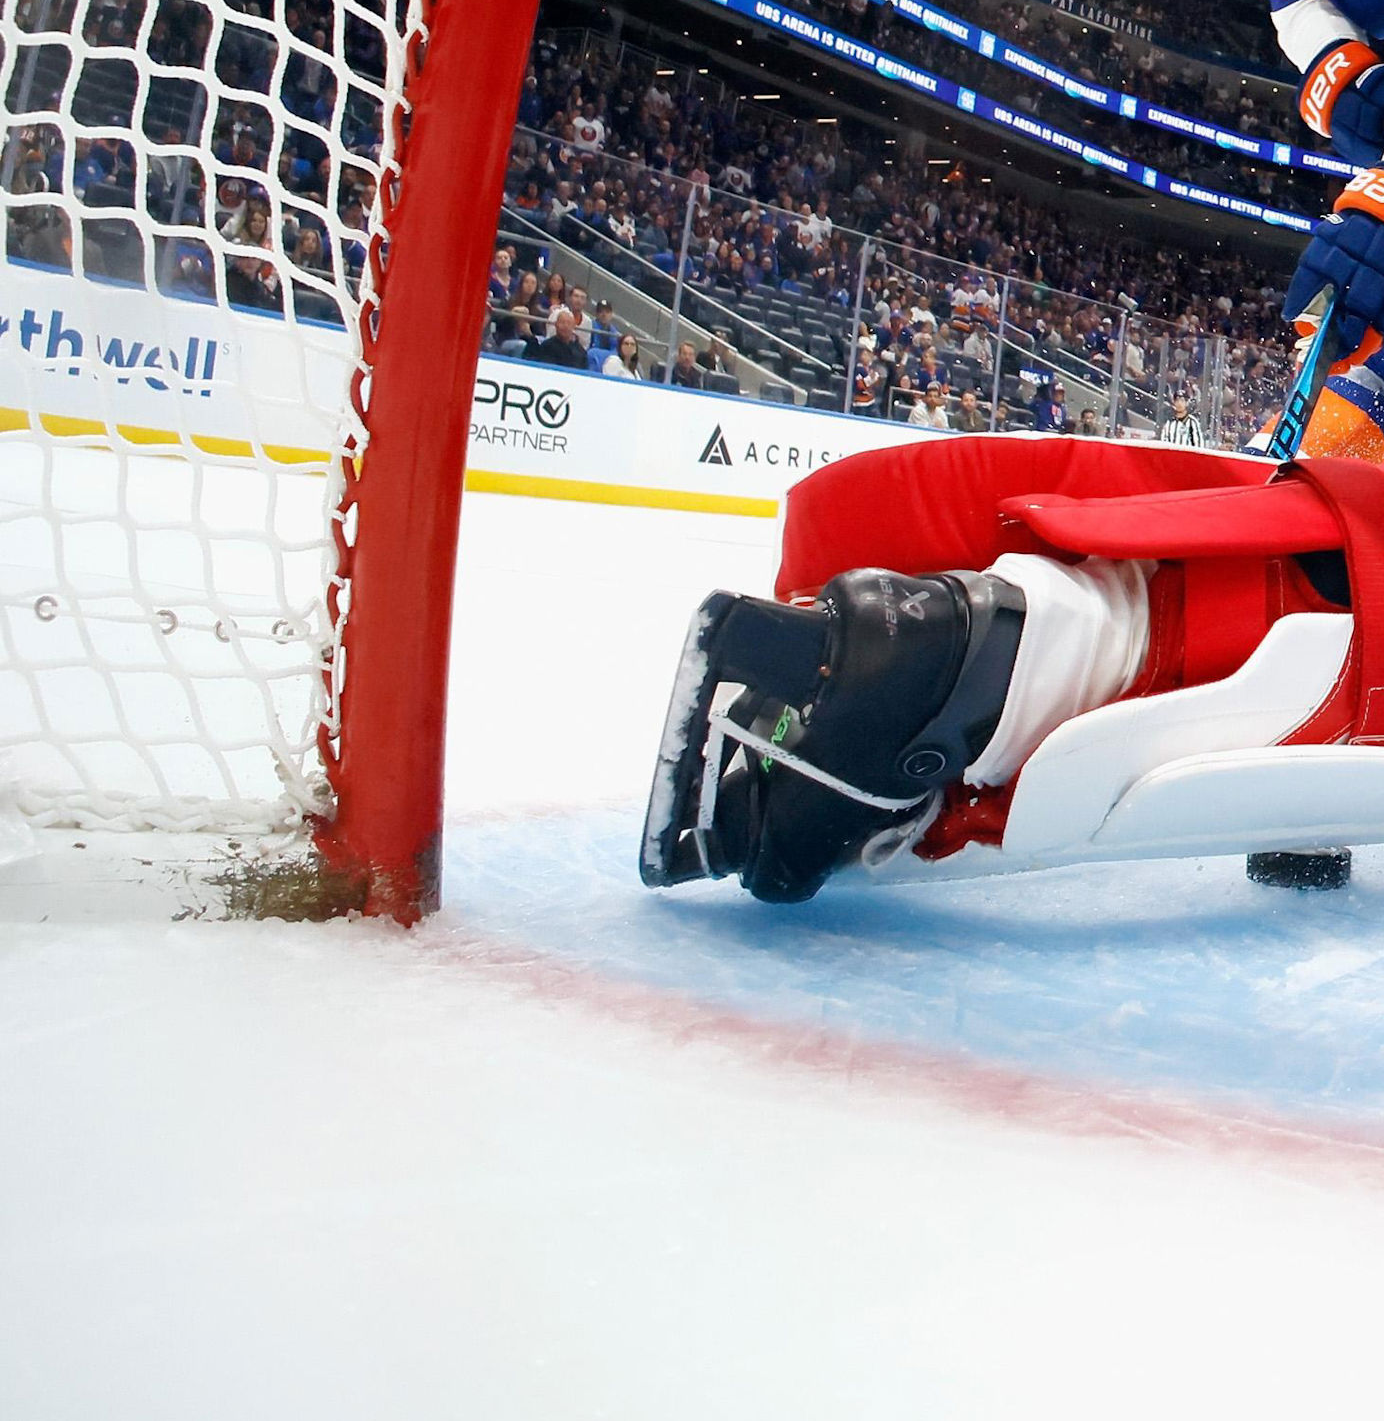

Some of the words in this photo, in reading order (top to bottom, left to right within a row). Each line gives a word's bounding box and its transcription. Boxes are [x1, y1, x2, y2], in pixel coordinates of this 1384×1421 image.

[923, 9, 969, 40] #WITHAMEX
[1079, 3, 1153, 42] LAFONTAINE
[756, 1, 781, 22] UBS
[781, 14, 820, 43] ARENA
[821, 31, 834, 47] IS
[835, 37, 876, 66] BETTER
[876, 56, 937, 93] #WITHAMEX
[1004, 48, 1046, 78] EXPERIENCE
[1046, 68, 1065, 87] MORE
[994, 107, 1013, 125] UBS
[1012, 116, 1042, 137] ARENA
[1042, 128, 1052, 141] IS
[1052, 132, 1083, 154] BETTER
[1148, 108, 1194, 133] EXPERIENCE
[1194, 122, 1216, 140] MORE
[1303, 154, 1352, 175] EXPERIENCE
[1170, 181, 1188, 197] UBS
[1188, 188, 1219, 205] ARENA
[1220, 196, 1230, 208] IS
[1230, 199, 1262, 217] BETTER
[744, 441, 842, 470] ACRIS
